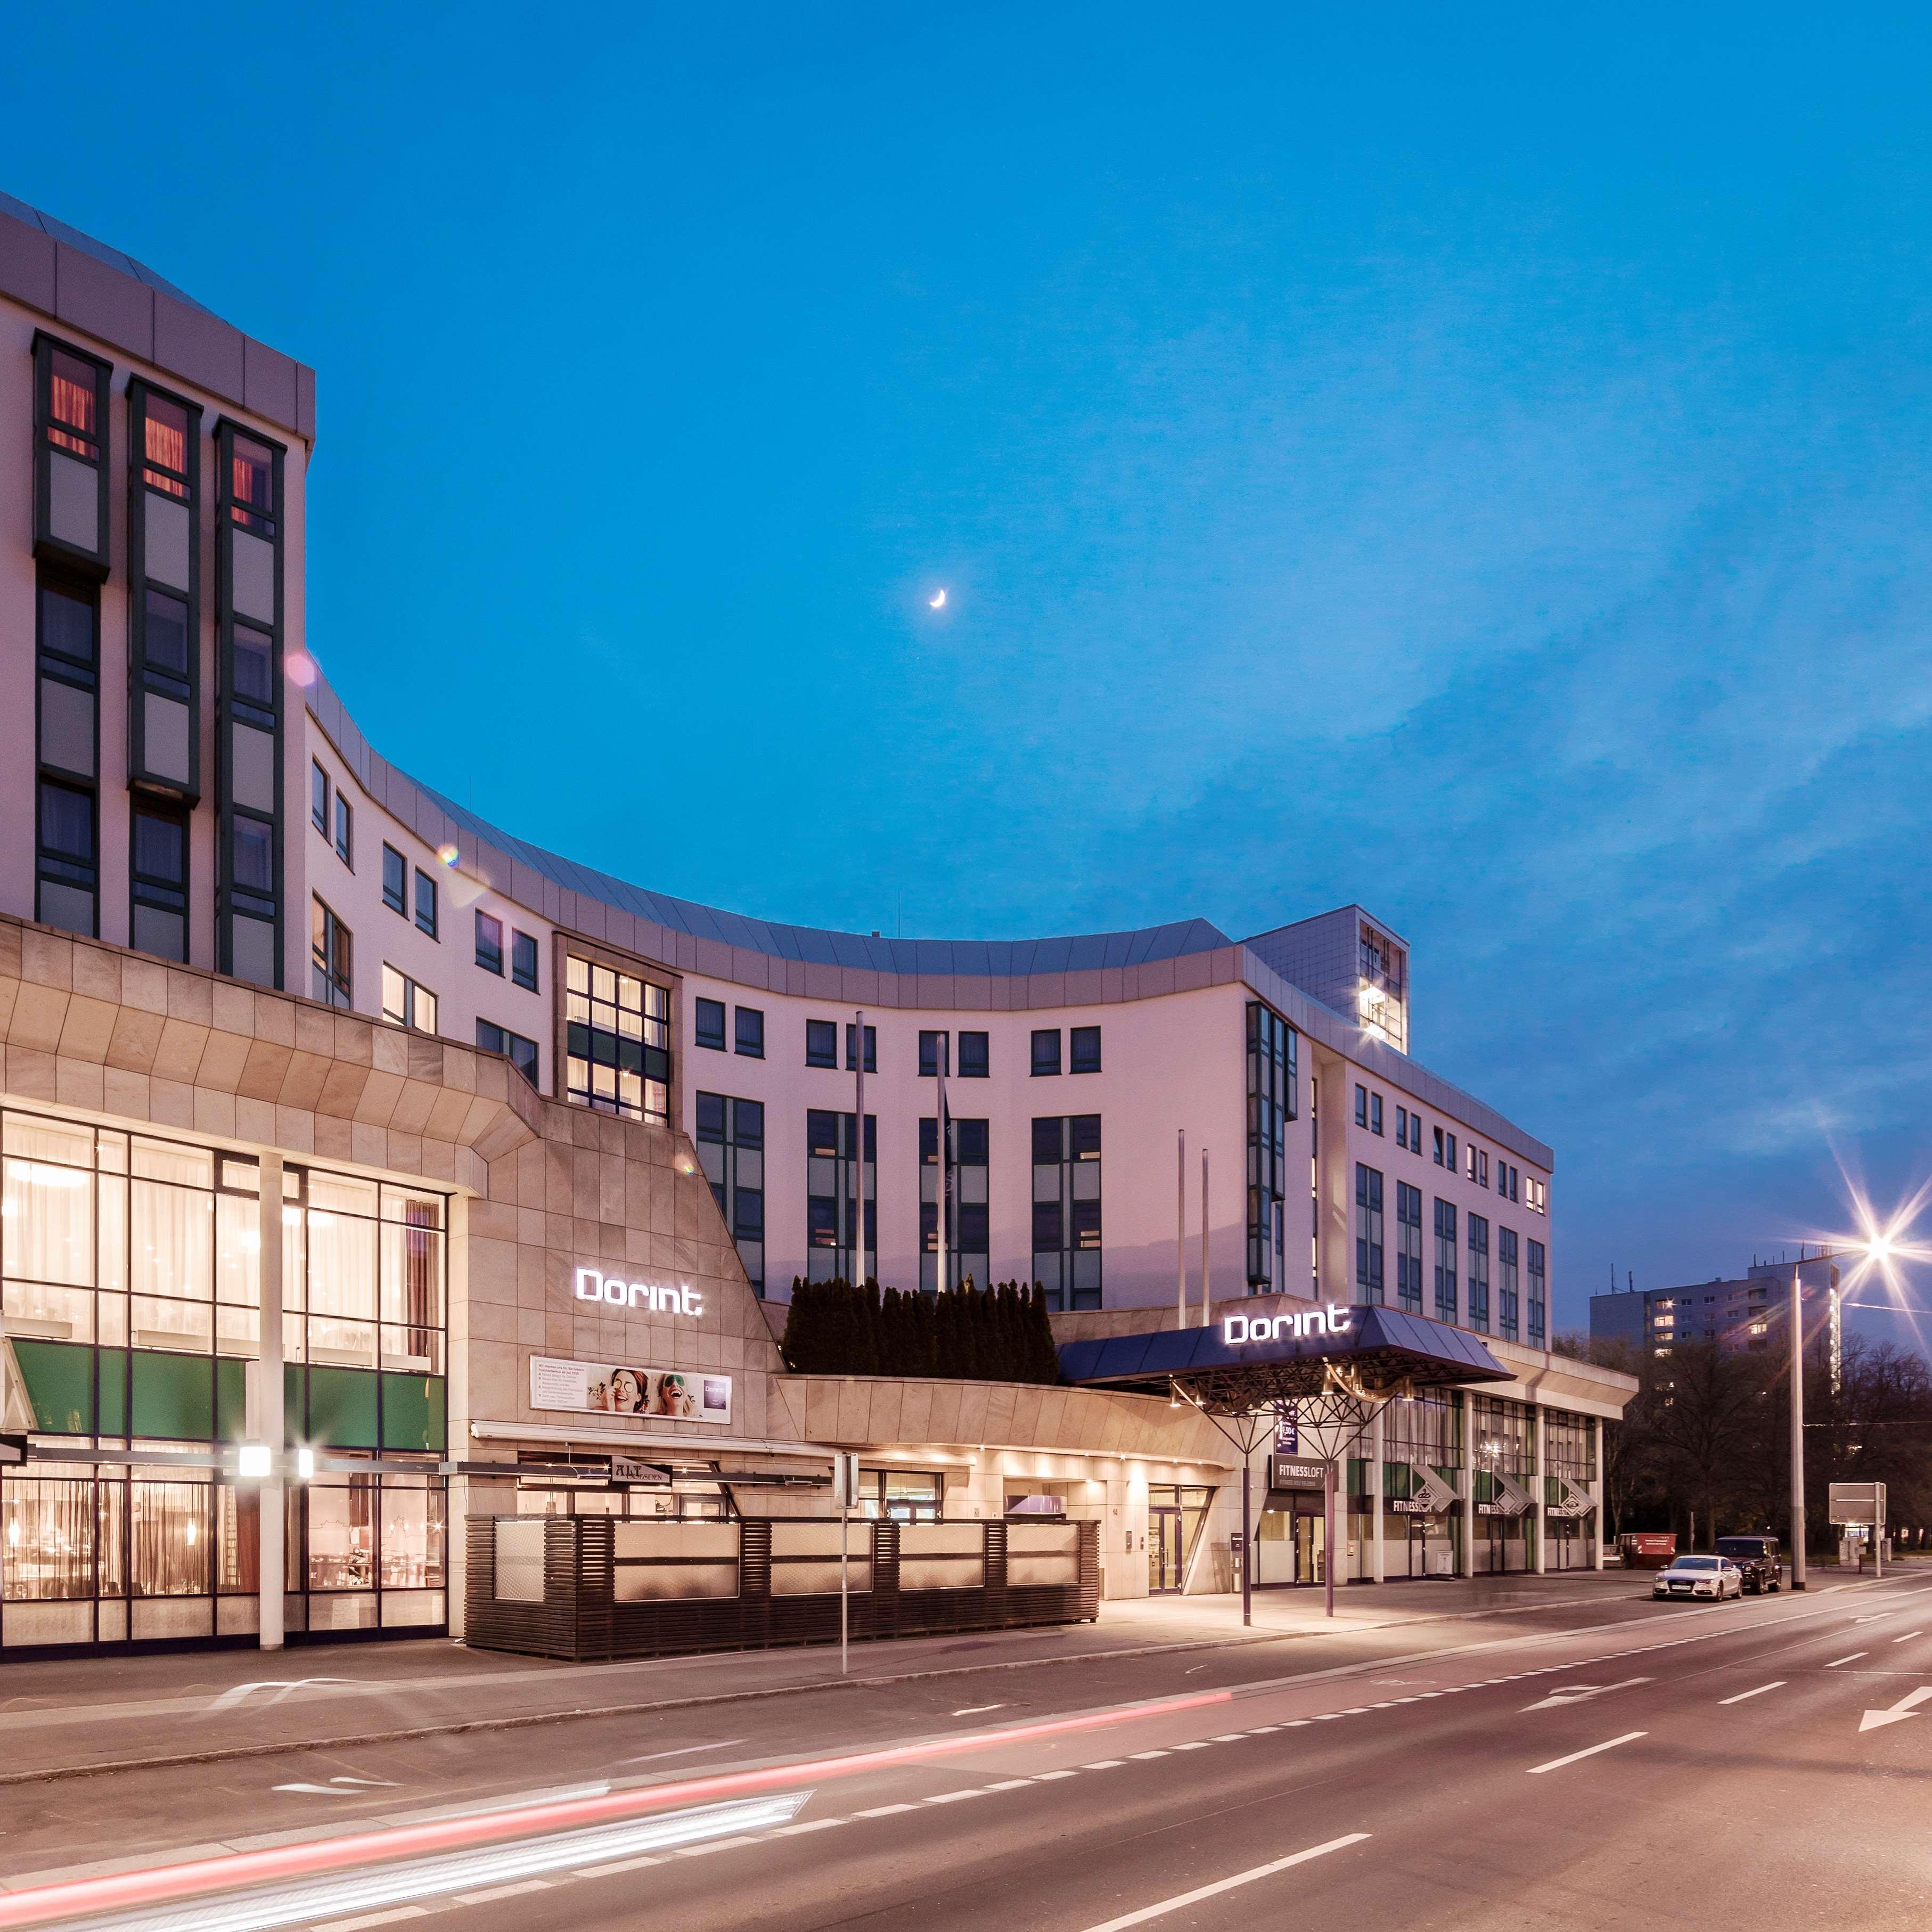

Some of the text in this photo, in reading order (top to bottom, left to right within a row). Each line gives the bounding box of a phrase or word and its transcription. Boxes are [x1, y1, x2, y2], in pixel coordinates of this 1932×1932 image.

[576, 1267, 703, 1316] Dorint
[1224, 1304, 1352, 1344] Dorint
[616, 1465, 642, 1477] ALT
[1279, 1464, 1324, 1478] FITNESSLOFT
